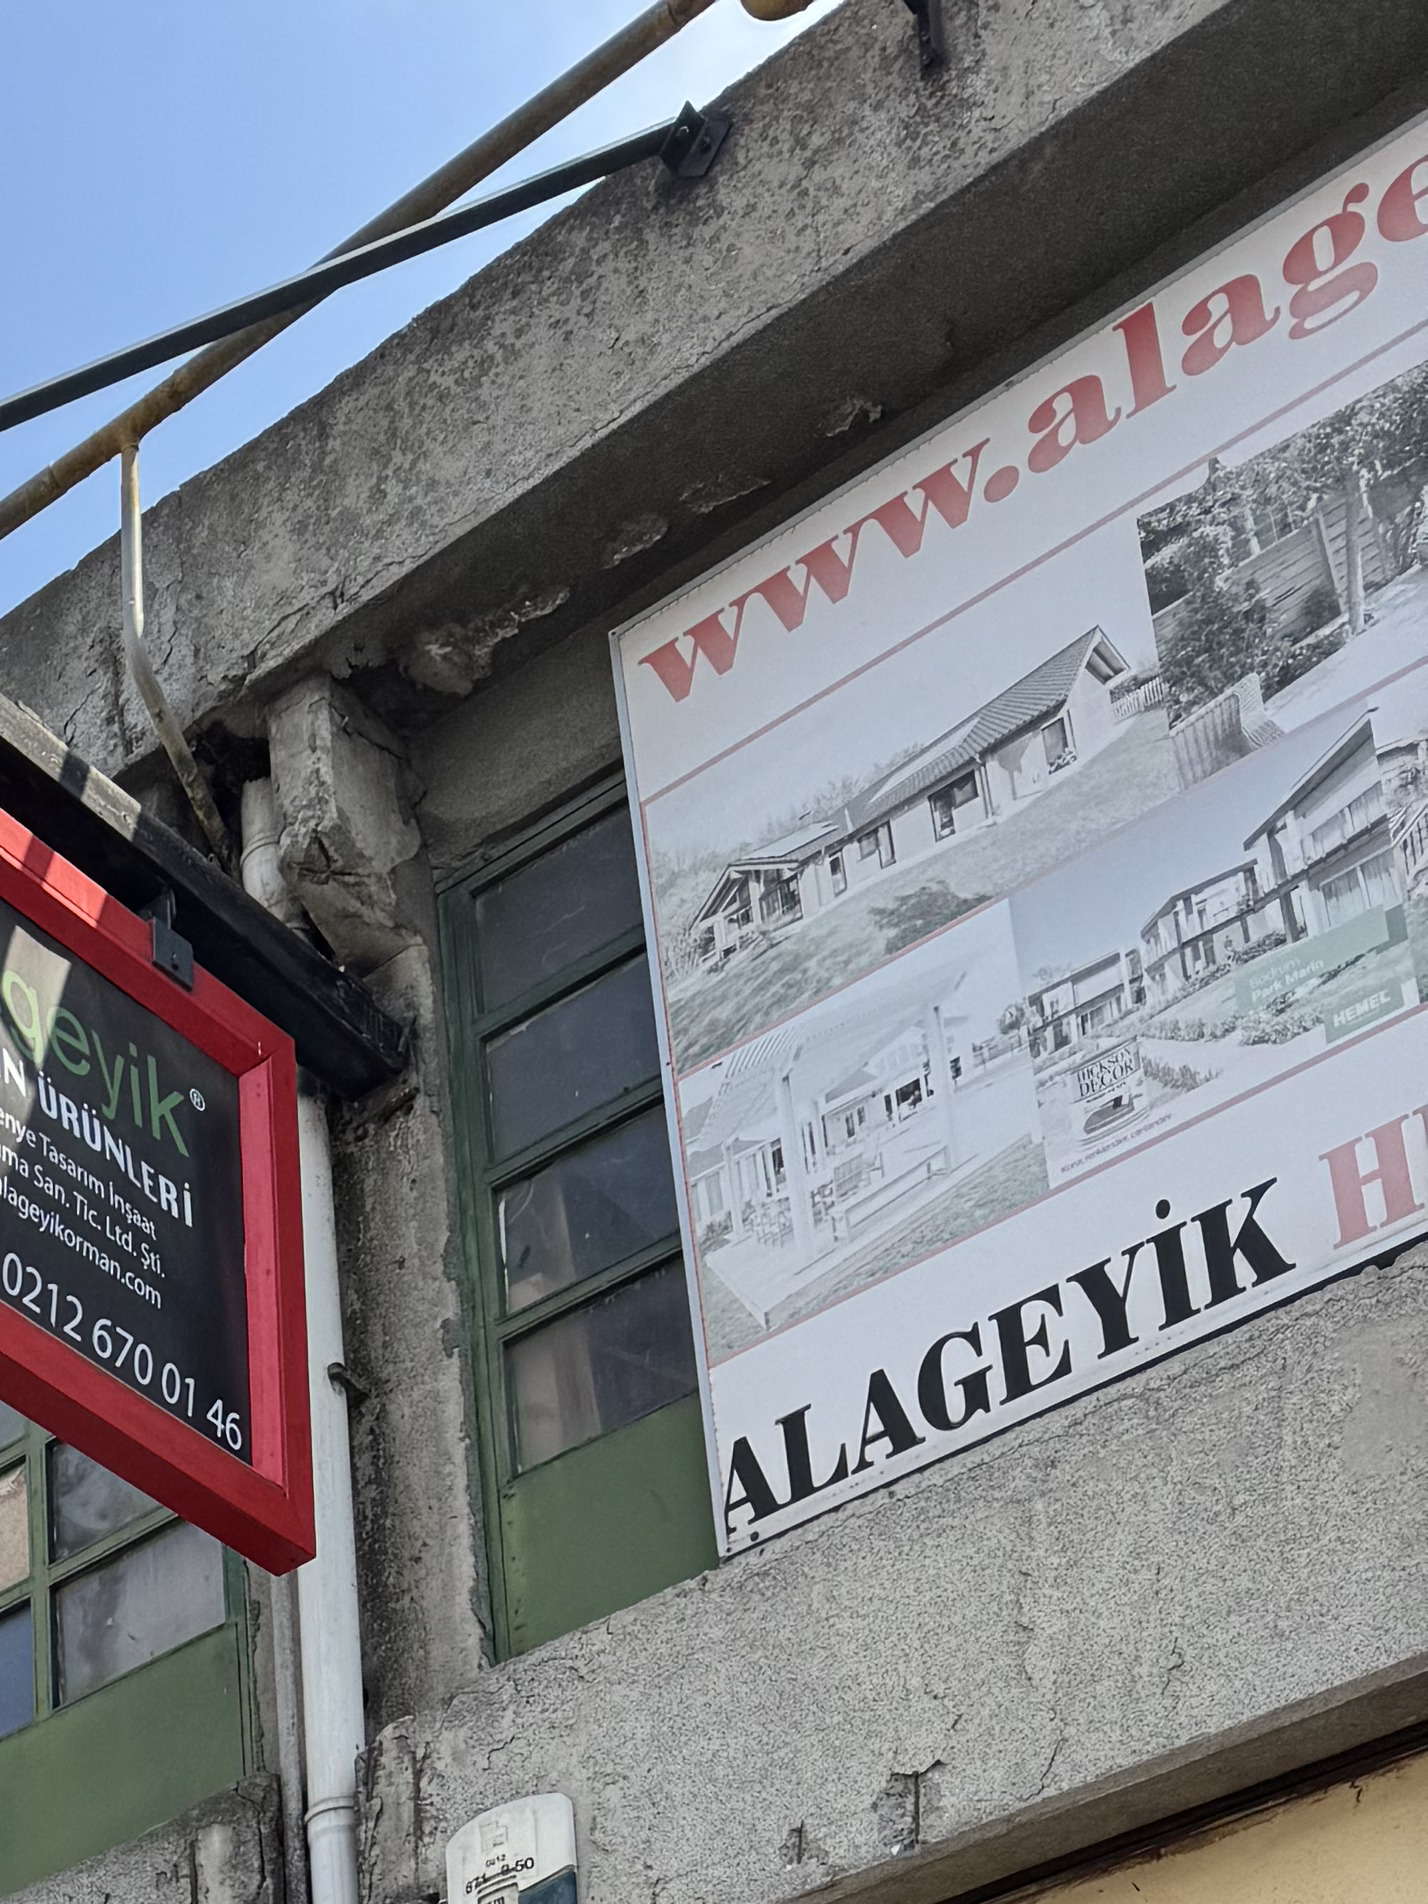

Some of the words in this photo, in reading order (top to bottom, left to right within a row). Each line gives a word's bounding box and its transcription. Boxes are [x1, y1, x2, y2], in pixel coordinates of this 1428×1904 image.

[33, 1165, 70, 1208] San.
[73, 1190, 102, 1230] Tic.
[105, 1215, 138, 1257] Ltd.
[140, 1244, 166, 1278] Şti.
[37, 1069, 193, 1228] ÜRÜNLERİ
[39, 1132, 105, 1199] Tasarım
[109, 1182, 158, 1241] İnşaat
[2, 1252, 84, 1342] 0212
[92, 1318, 154, 1386] 670
[161, 1362, 195, 1418] 01
[206, 1399, 242, 1451] 46
[723, 1176, 1297, 1535] ALAGEYİK
[1318, 1104, 1428, 1250] H
